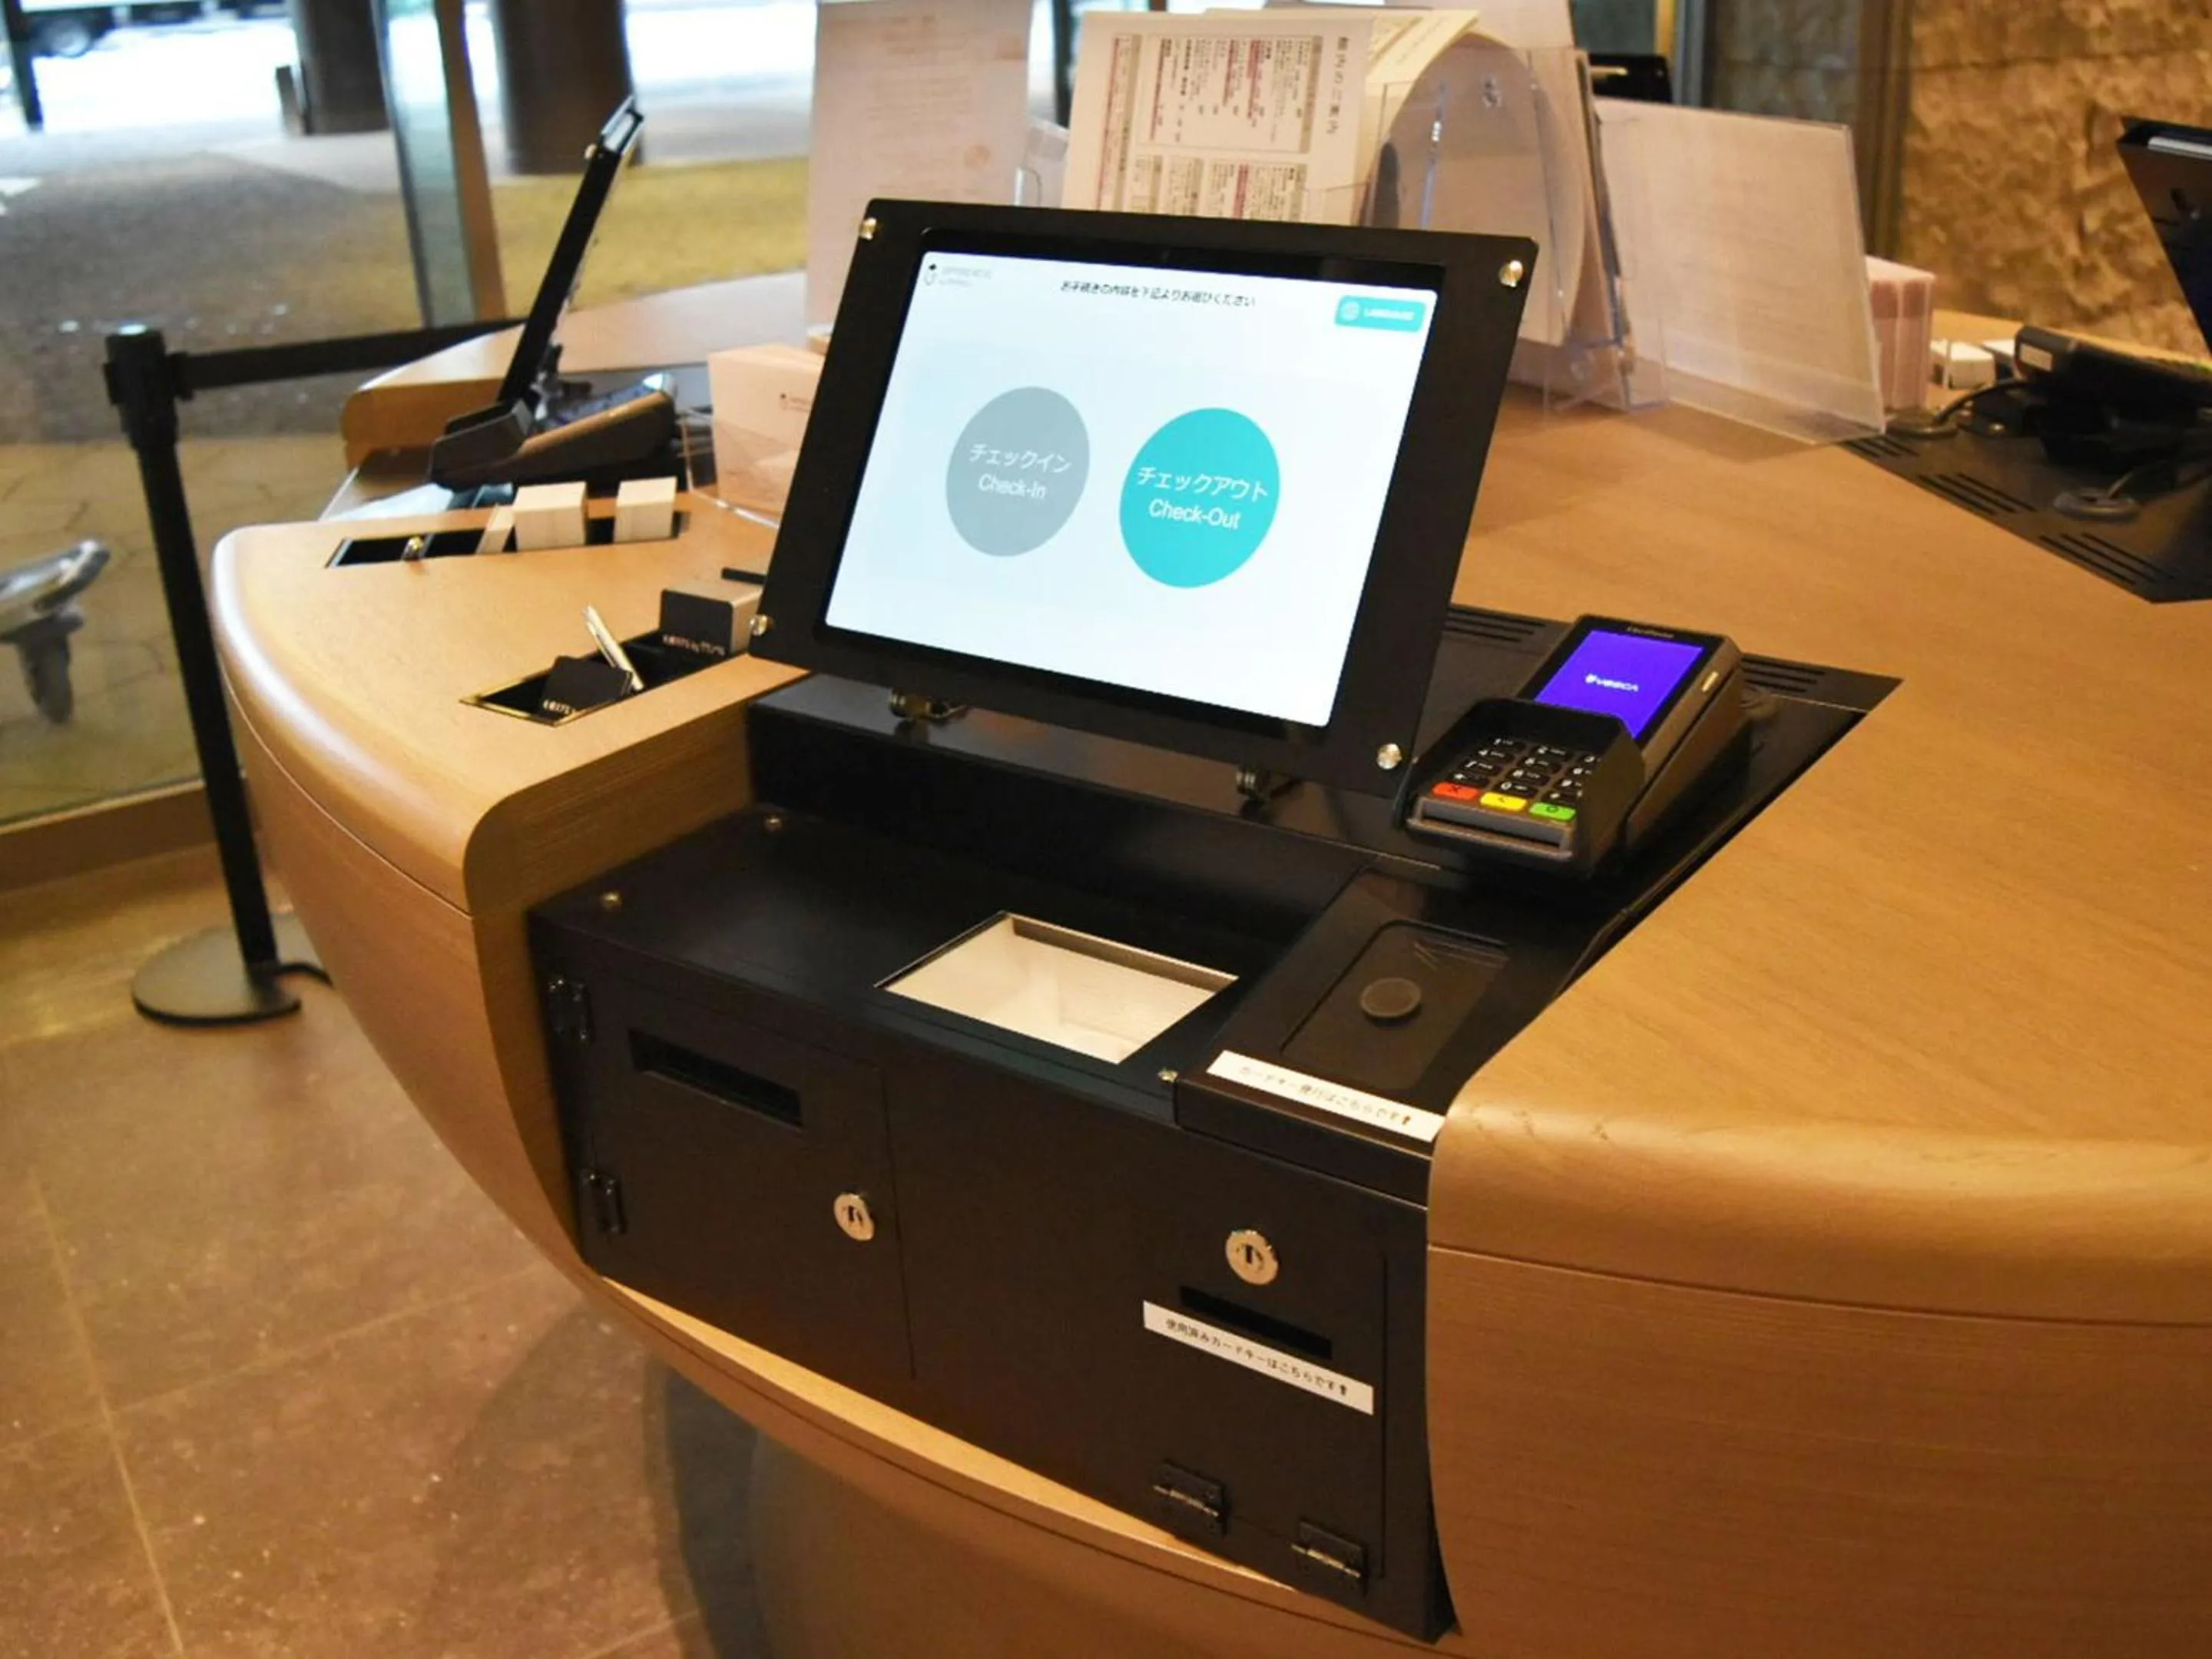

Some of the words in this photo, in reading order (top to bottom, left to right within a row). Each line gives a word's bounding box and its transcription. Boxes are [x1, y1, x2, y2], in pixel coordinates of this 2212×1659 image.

[969, 443, 1071, 474] チェックイン
[978, 473, 1046, 499] Check-In
[1137, 465, 1269, 503] チェックアウト
[1148, 497, 1241, 530] Check-Out
